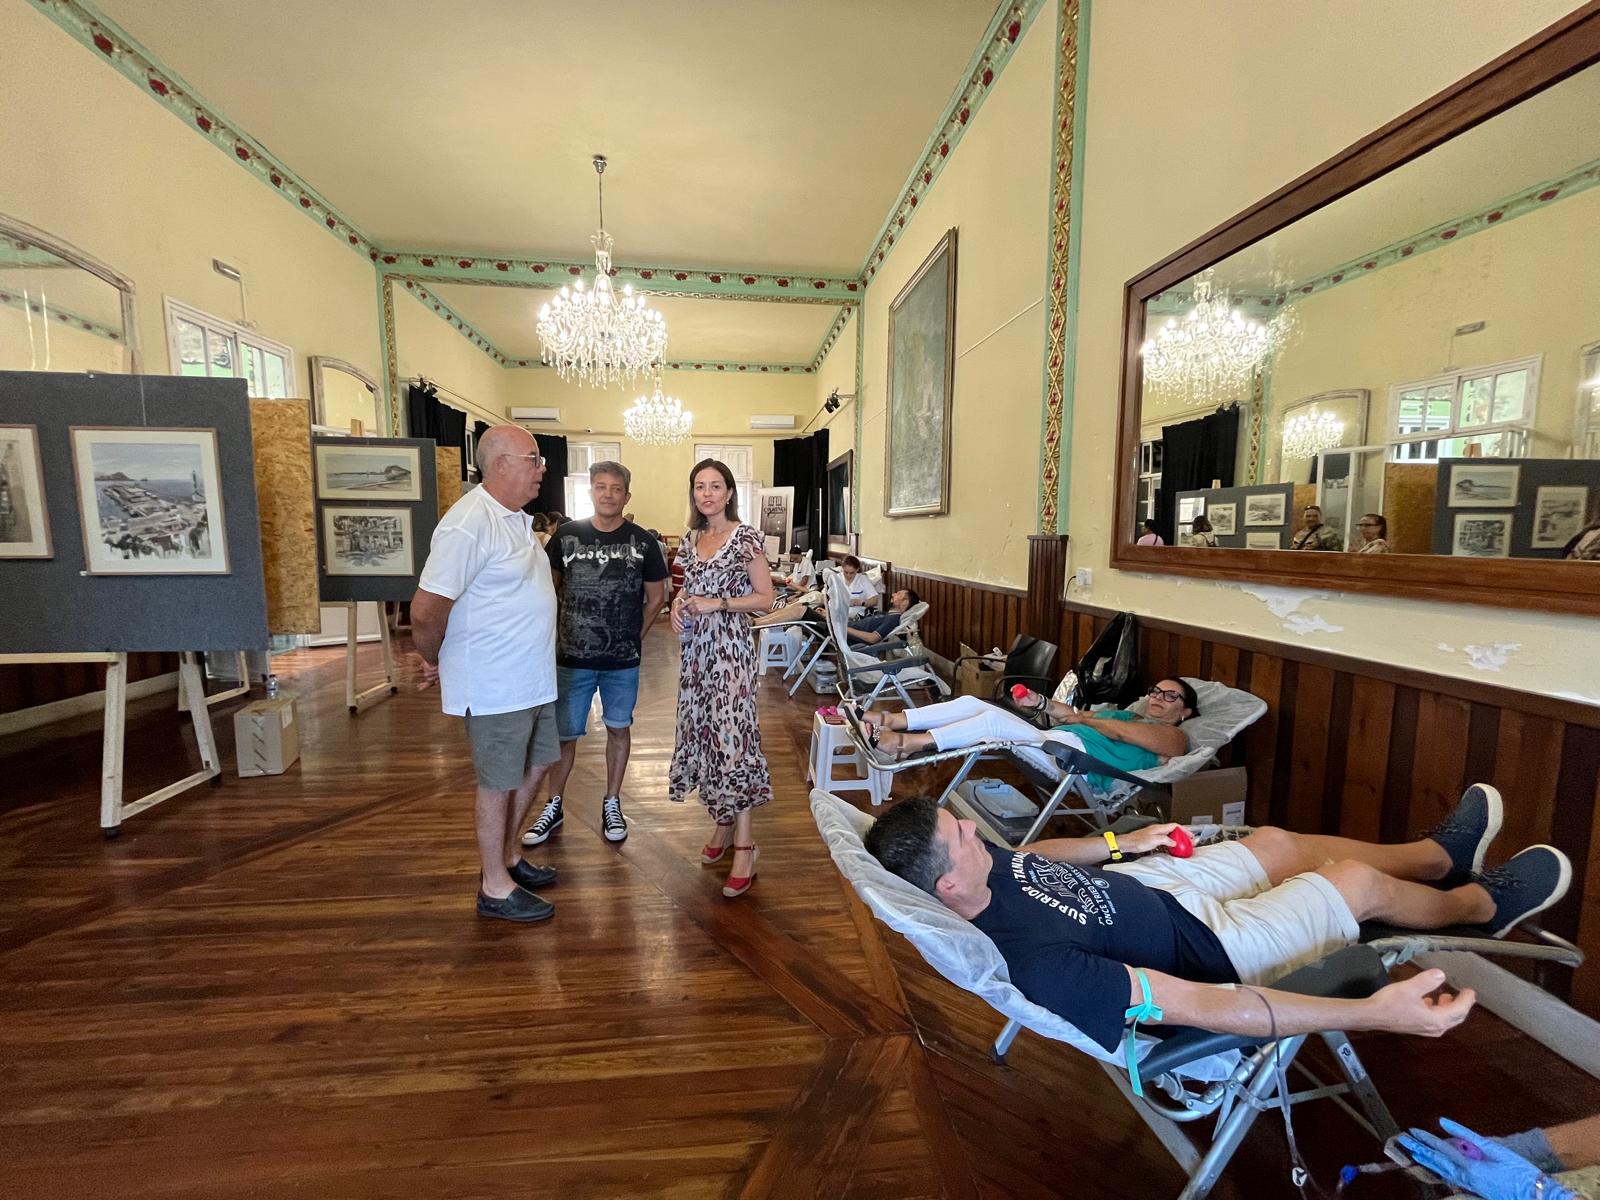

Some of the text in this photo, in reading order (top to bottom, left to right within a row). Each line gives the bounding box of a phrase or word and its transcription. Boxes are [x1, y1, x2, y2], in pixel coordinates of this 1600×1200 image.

[560, 534, 644, 568] Desigual
[1021, 885, 1088, 926] SUPERIOR
[1087, 886, 1104, 904] TRIED
[1099, 904, 1114, 926] ONCE
